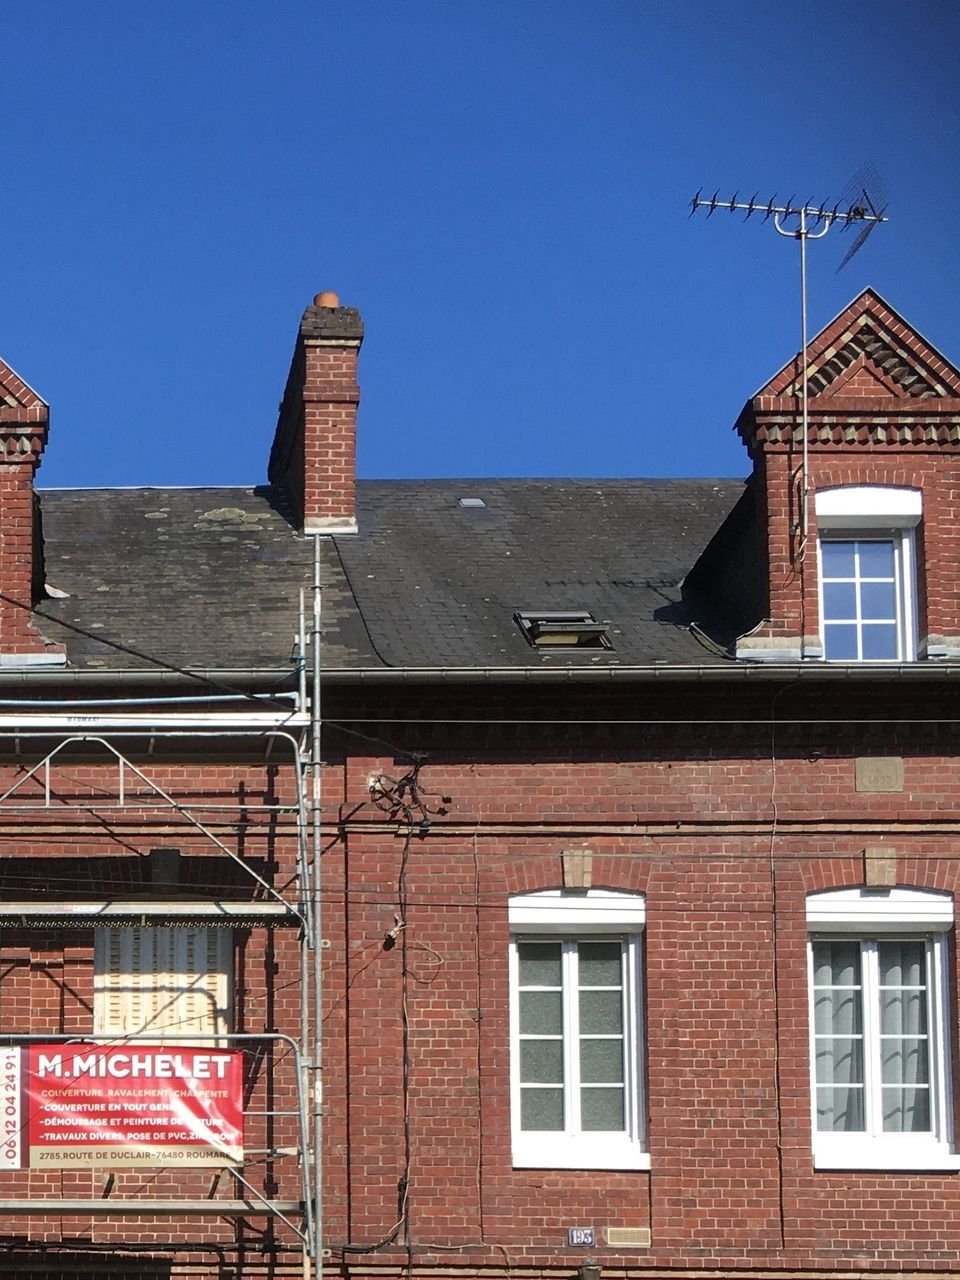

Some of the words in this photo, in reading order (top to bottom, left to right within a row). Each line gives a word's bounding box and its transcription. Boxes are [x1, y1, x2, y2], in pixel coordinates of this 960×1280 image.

[5, 1054, 17, 1070] 91
[38, 1054, 231, 1079] M.MICHELET
[5, 1074, 17, 1092] 24
[41, 1089, 103, 1097] COUVERTURE
[173, 1090, 229, 1098] CHARPENTE
[5, 1096, 17, 1115] 04
[108, 1103, 121, 1111] EN
[123, 1103, 148, 1111] TOUT
[5, 1119, 17, 1136] 12
[110, 1118, 121, 1126] ET
[123, 1118, 168, 1126] PEINTURE
[127, 1132, 151, 1140] POSE
[153, 1132, 166, 1140] DE
[5, 1140, 17, 1159] 06
[95, 1151, 108, 1159] DE
[186, 1151, 232, 1160] ROUMARE
[572, 1229, 591, 1244] 193
